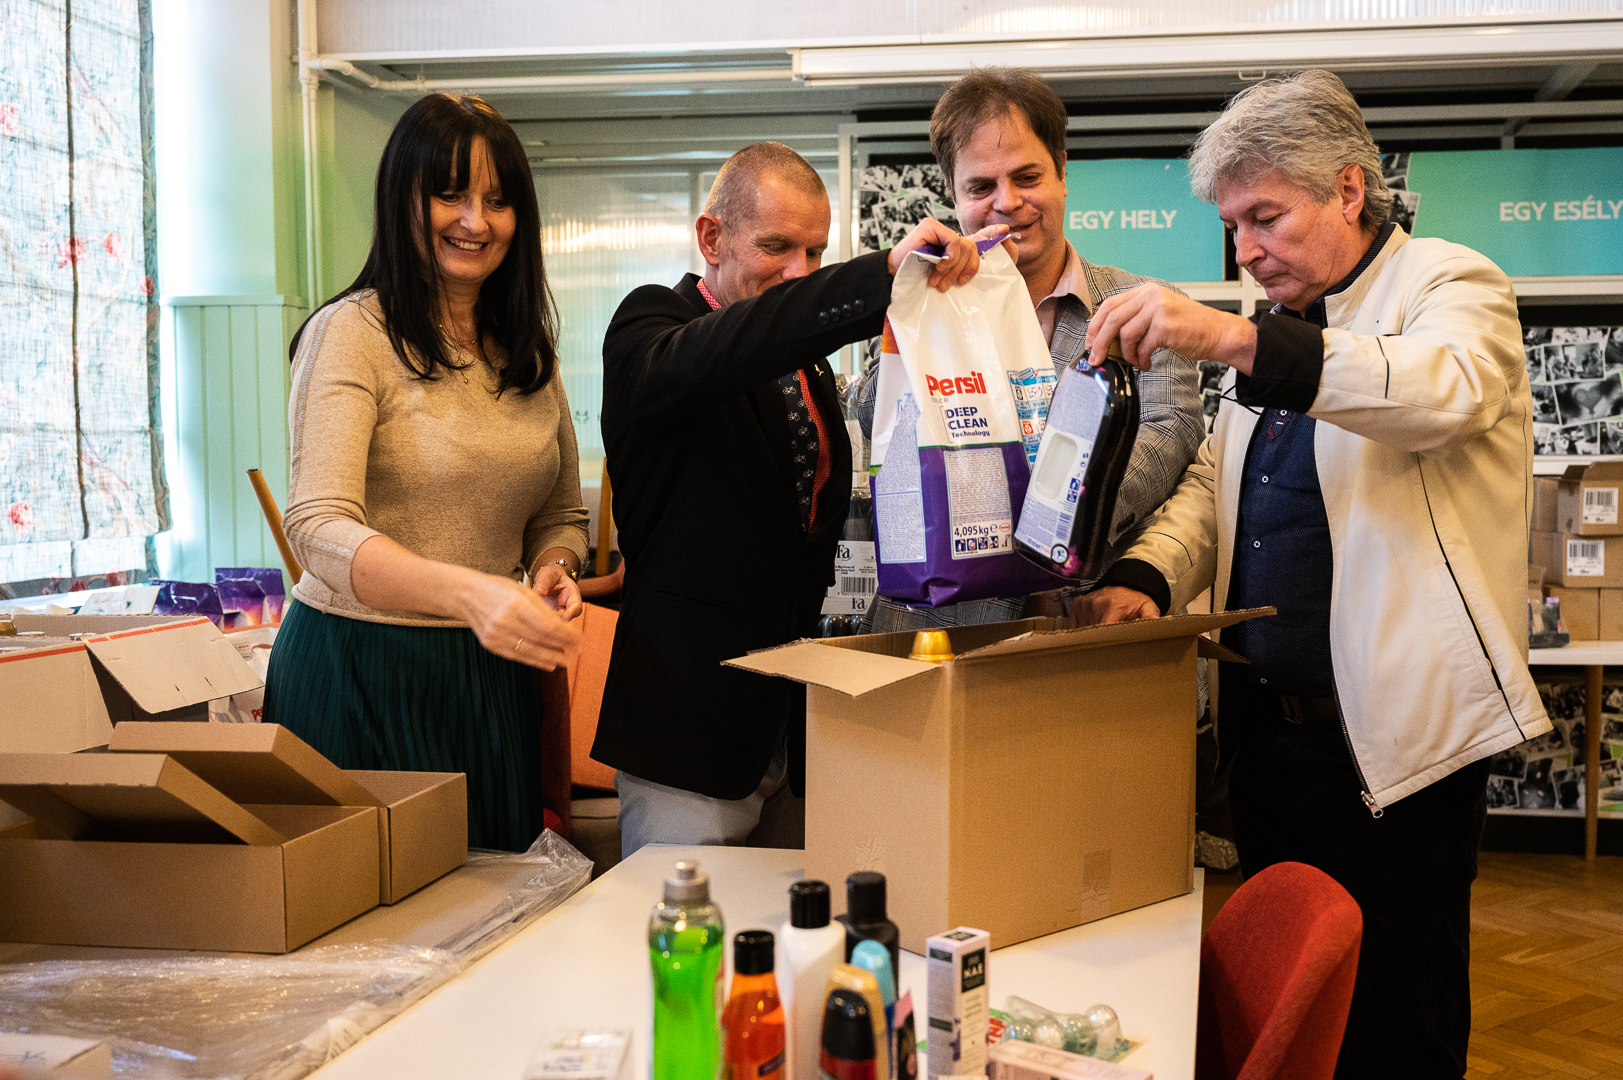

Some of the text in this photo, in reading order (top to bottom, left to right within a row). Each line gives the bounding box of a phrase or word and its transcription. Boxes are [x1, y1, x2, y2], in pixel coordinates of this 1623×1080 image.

[1500, 194, 1623, 221] EGY ESÉLY
[1069, 209, 1177, 230] EGY HELY
[925, 370, 987, 396] Persil
[945, 406, 978, 419] DEEP
[948, 417, 989, 430] CLEAN
[951, 430, 991, 438] Technology
[836, 544, 851, 560] Fa
[851, 597, 866, 610] Fa
